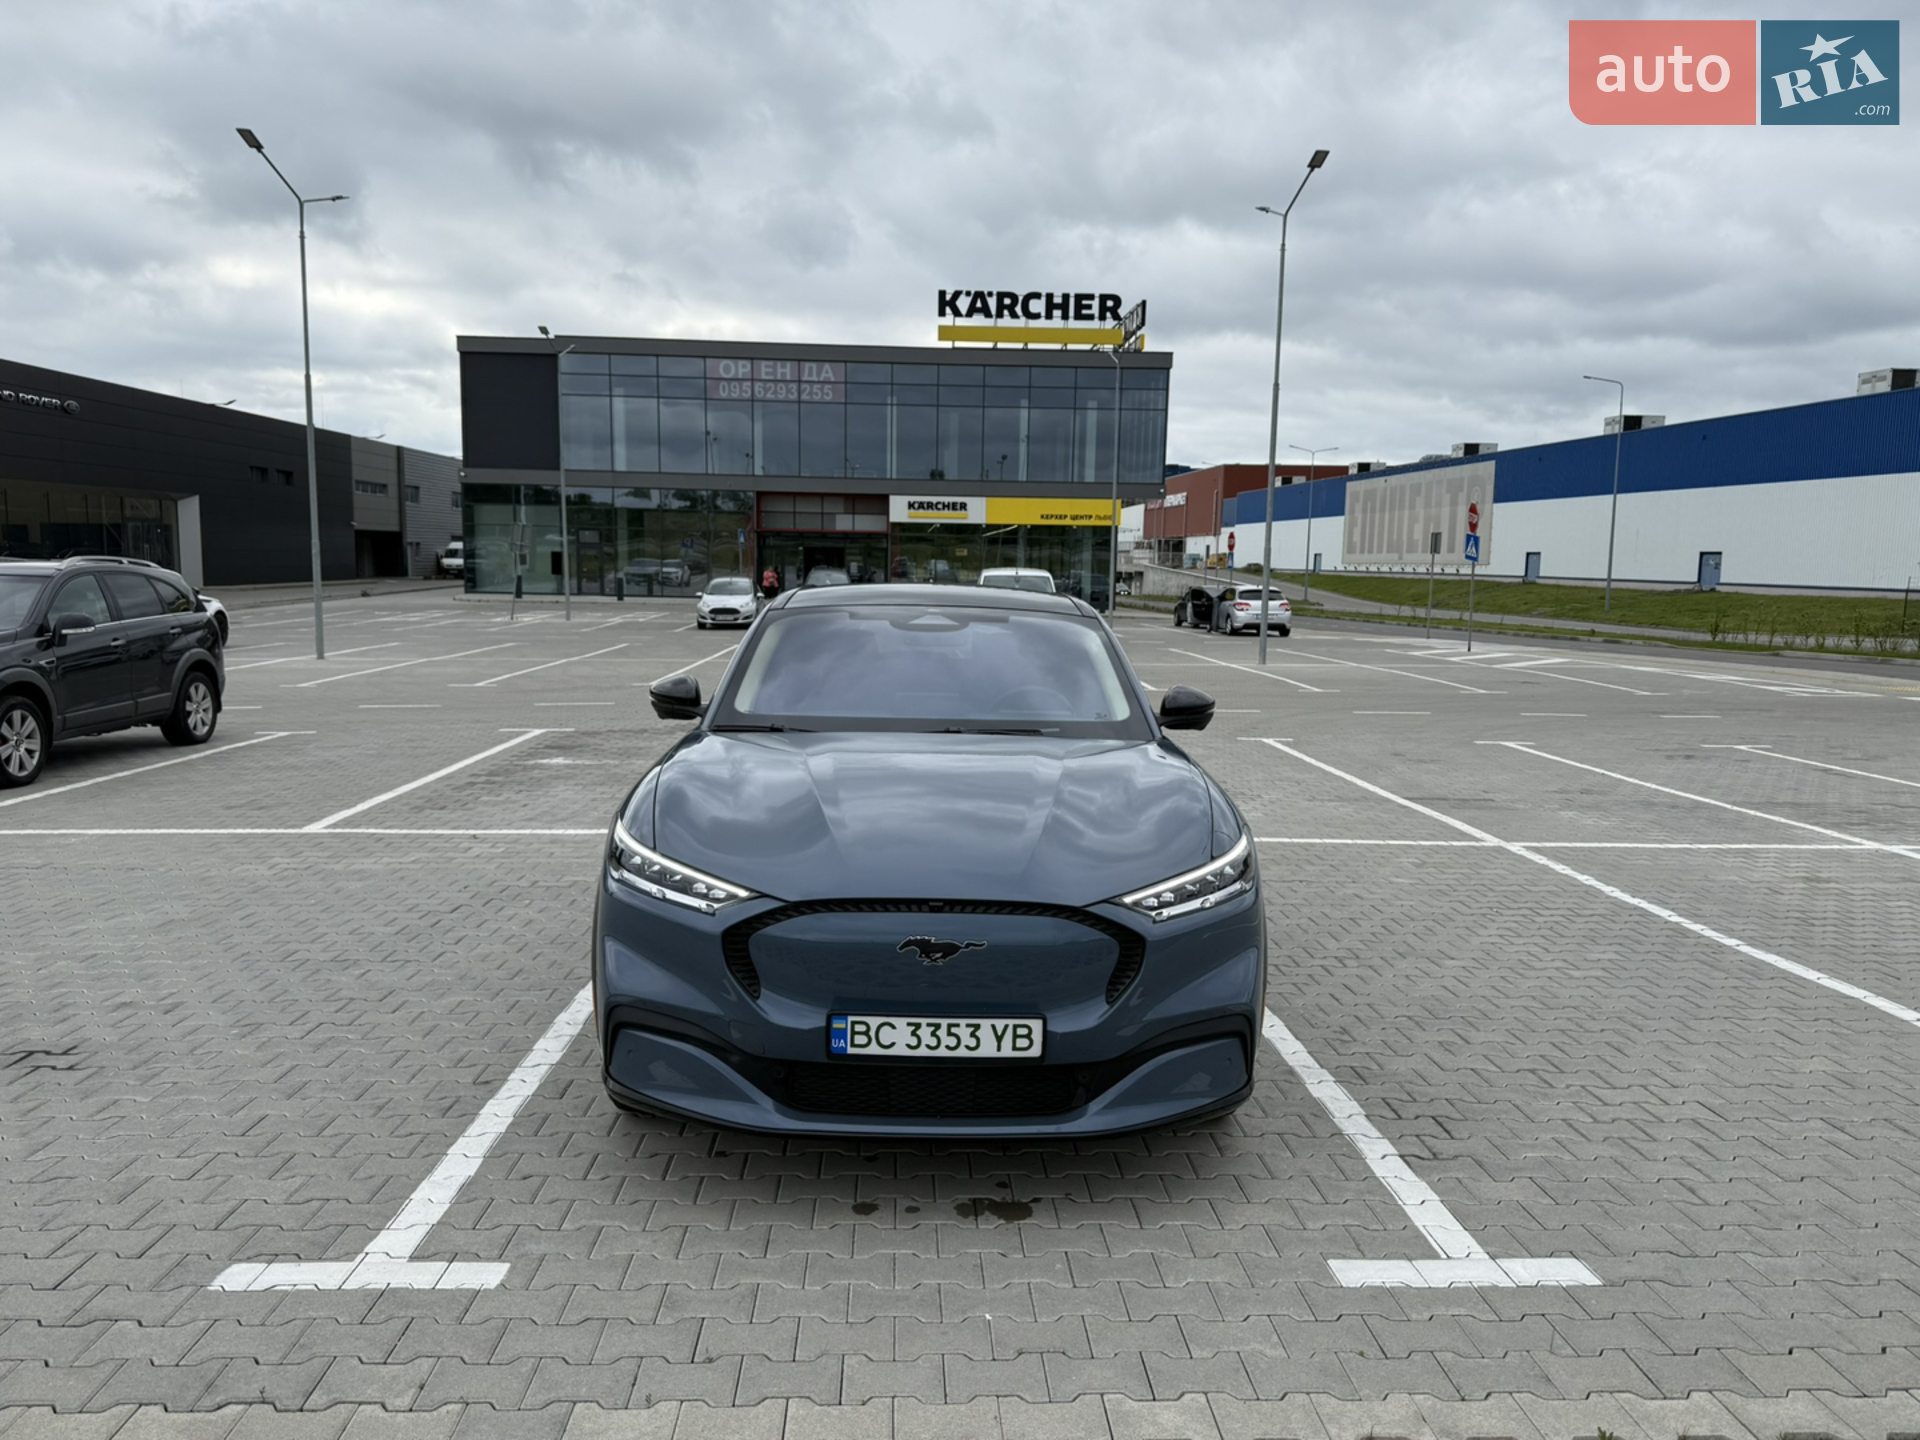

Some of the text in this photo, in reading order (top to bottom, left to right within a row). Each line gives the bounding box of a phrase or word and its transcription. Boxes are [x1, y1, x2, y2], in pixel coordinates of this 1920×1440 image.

[938, 289, 1124, 322] KÄRCHER
[719, 382, 833, 400] 0956293255
[18, 393, 61, 409] ROVER
[907, 500, 968, 512] KÄRCHER
[1070, 514, 1094, 522] ЦЕНТР
[831, 1038, 846, 1049] UA
[849, 1020, 1034, 1052] BC 3353 YB
